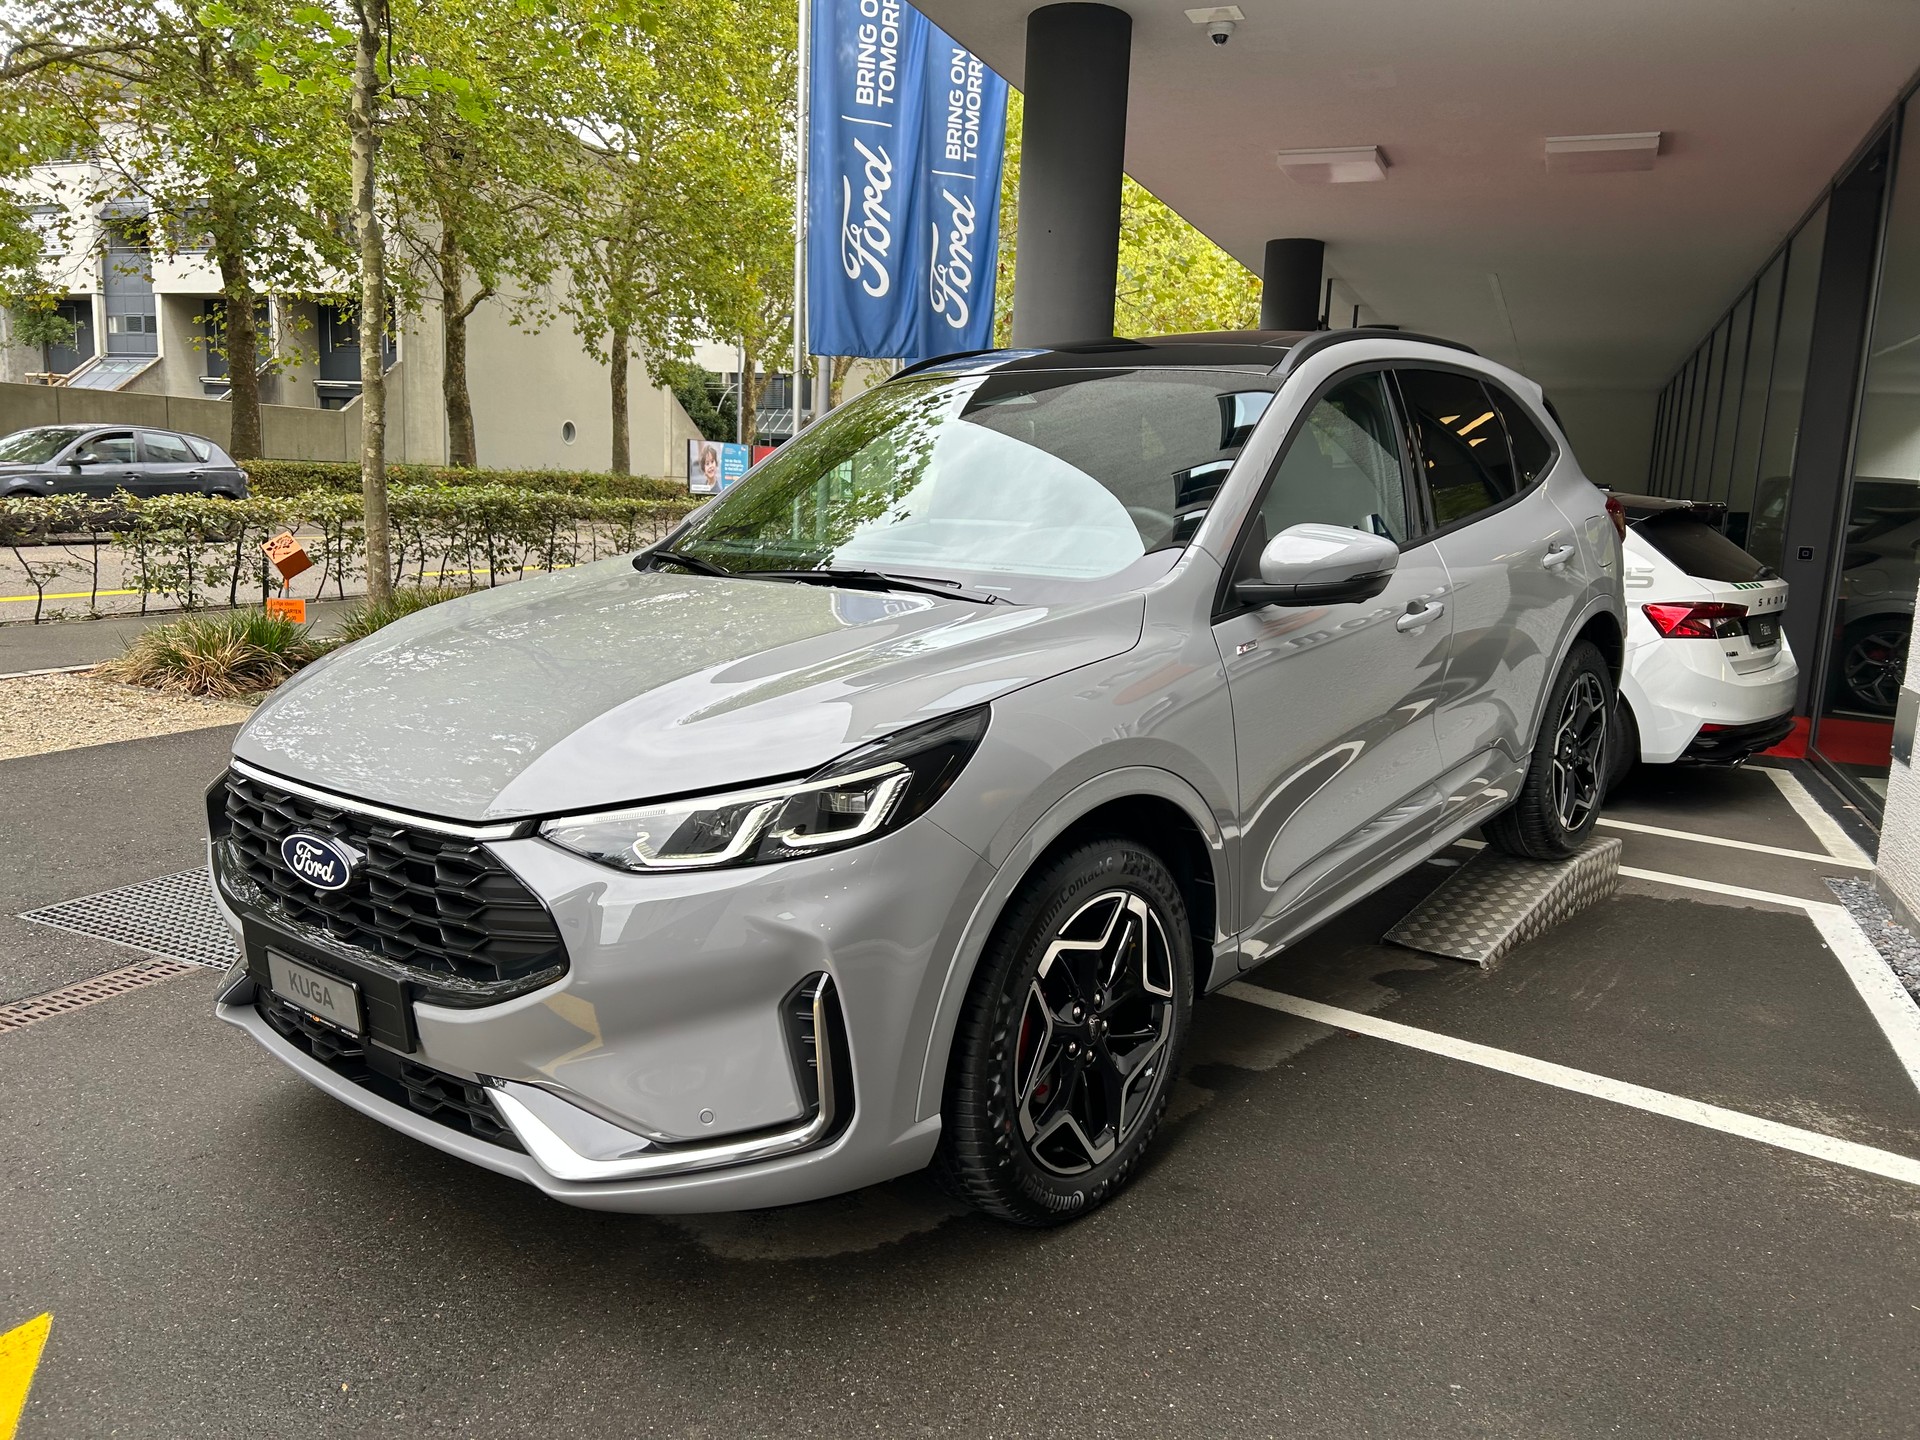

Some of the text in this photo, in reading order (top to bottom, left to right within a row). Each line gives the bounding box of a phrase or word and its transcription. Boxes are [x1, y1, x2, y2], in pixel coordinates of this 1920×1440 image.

[856, 24, 878, 105] BRING
[945, 48, 967, 160] BRING ON
[841, 137, 893, 298] Ford
[929, 188, 976, 330] Ford
[293, 841, 335, 883] Ford
[288, 970, 335, 1010] KUGA
